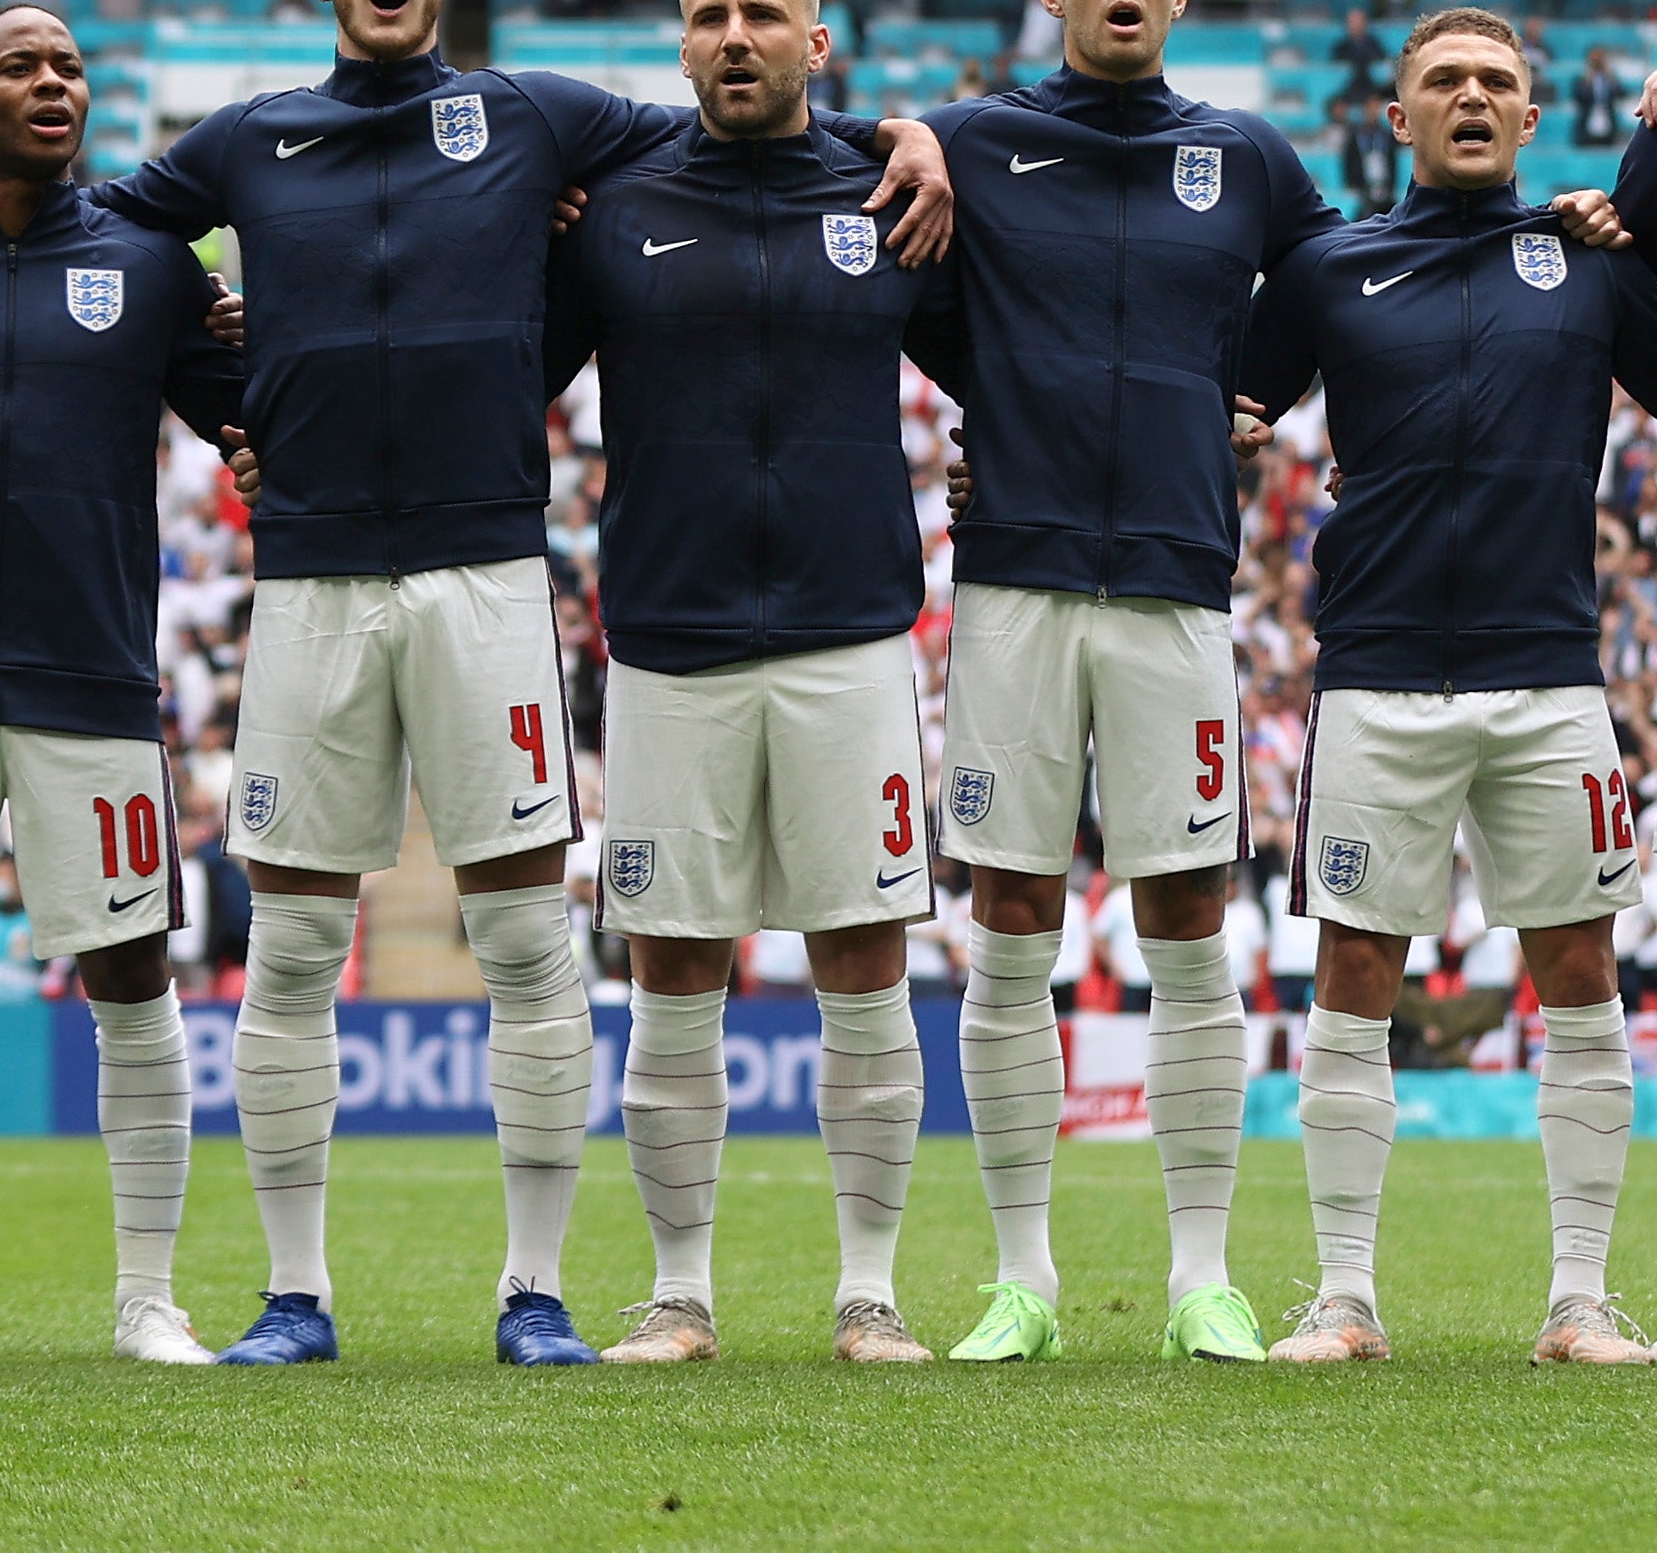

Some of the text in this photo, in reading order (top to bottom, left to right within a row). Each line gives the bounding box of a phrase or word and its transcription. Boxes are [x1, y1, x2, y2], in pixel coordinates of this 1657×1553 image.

[509, 702, 548, 785] 4
[1195, 718, 1225, 802] 5
[92, 793, 161, 880] 10
[881, 772, 914, 858] 3
[1581, 769, 1634, 853] 12
